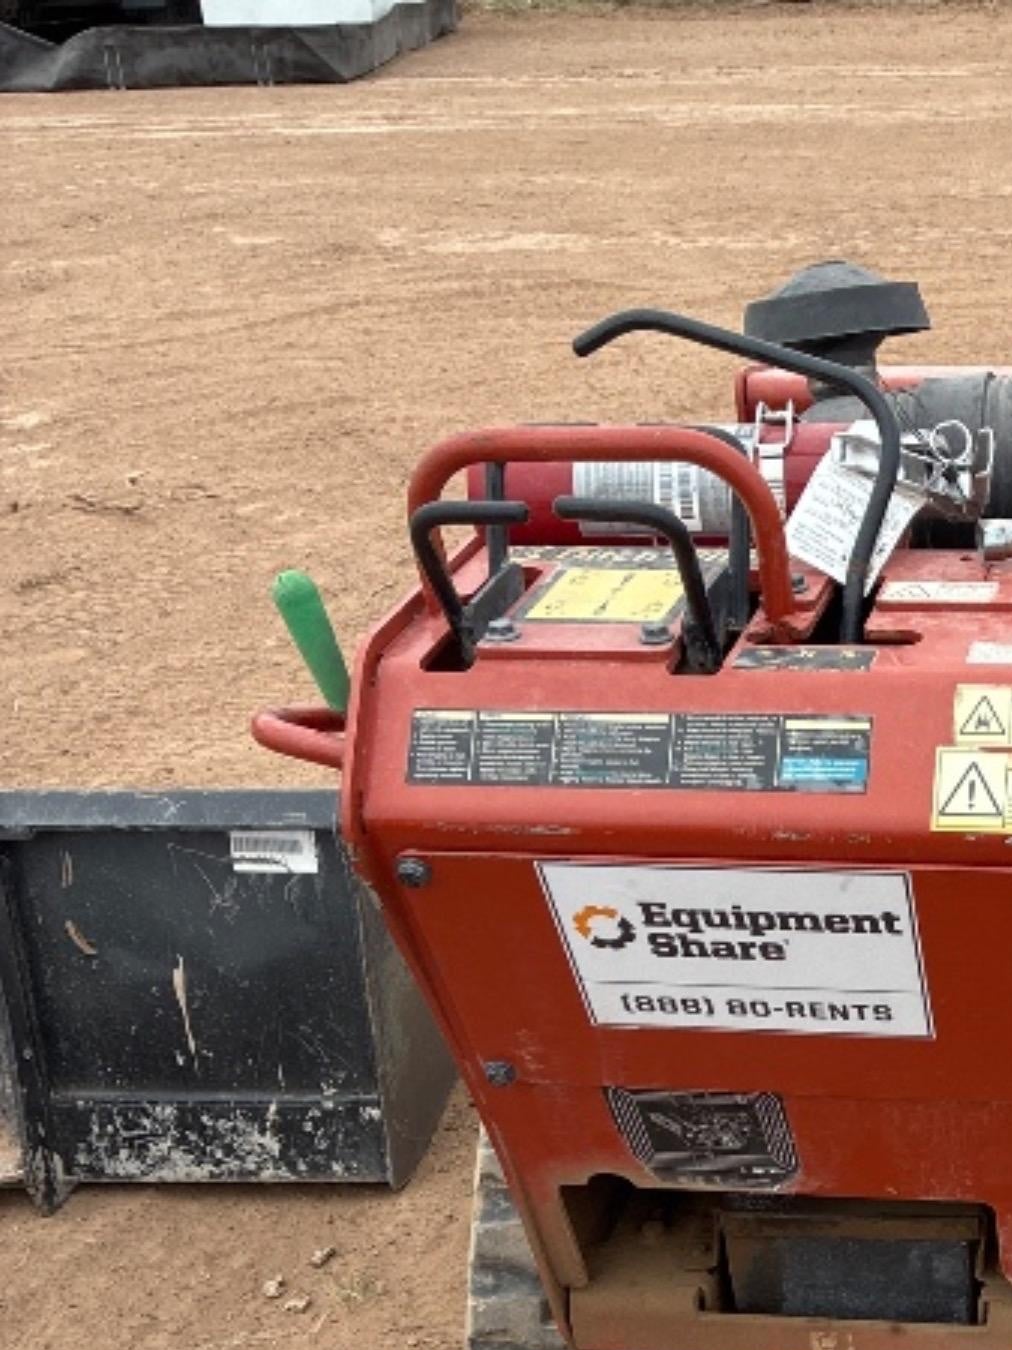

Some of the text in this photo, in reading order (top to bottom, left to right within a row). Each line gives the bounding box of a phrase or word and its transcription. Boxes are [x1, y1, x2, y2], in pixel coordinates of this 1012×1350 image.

[637, 902, 904, 936] Equipment
[647, 932, 786, 961] Share
[621, 993, 893, 1022] (888) 80-RENTS
